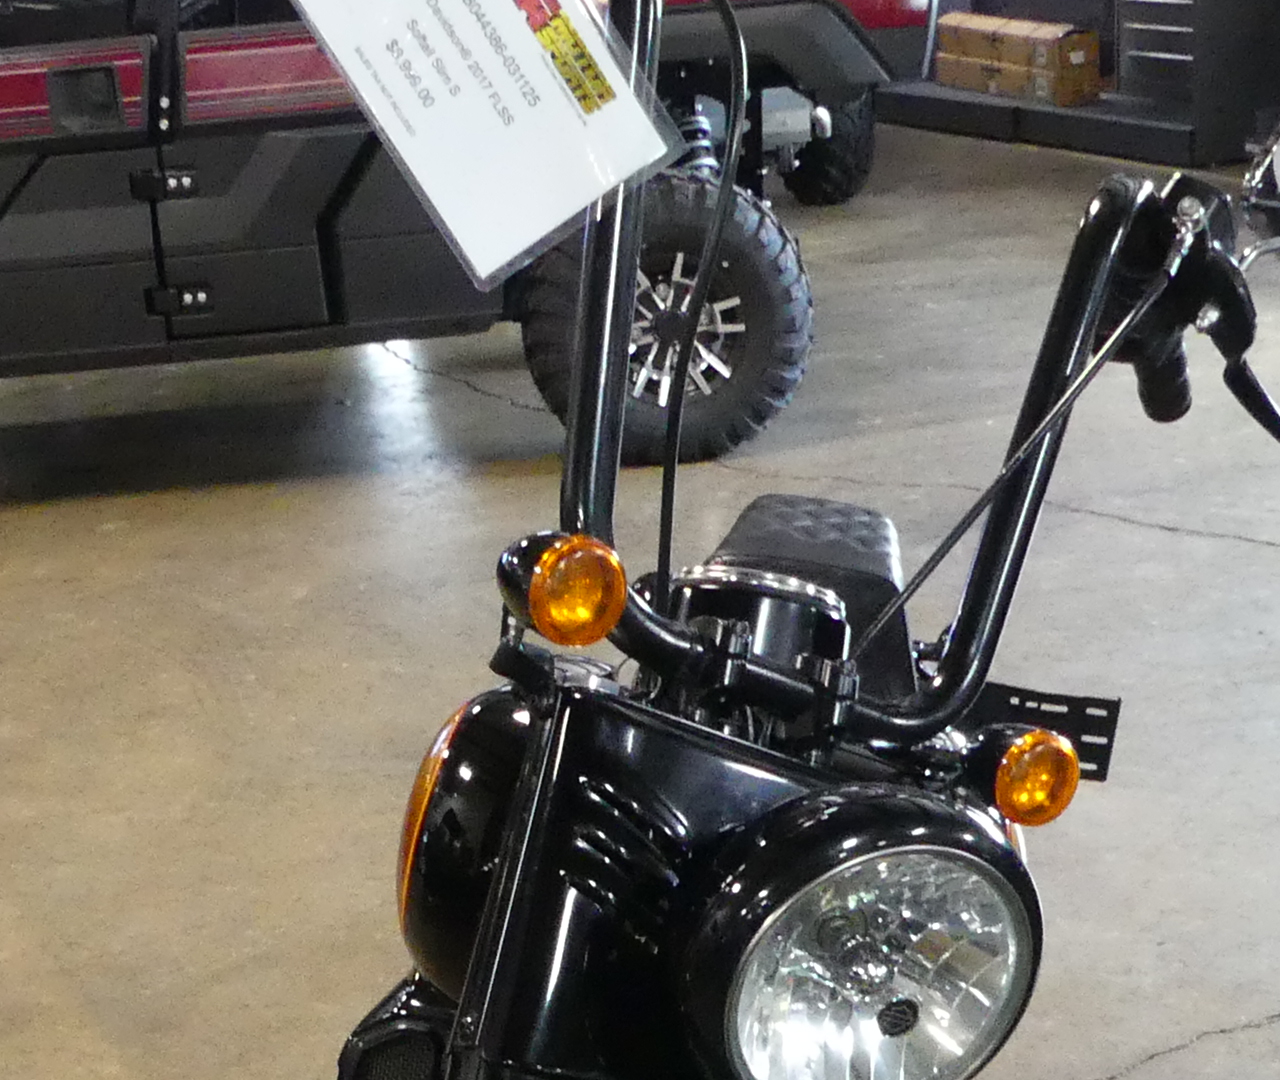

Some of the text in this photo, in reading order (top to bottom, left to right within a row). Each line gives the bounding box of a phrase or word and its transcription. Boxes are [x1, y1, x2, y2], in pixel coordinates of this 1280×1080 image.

[406, 19, 461, 98] Softail Slim S
[467, 60, 494, 91] 2017
[488, 91, 515, 127] FLSS
